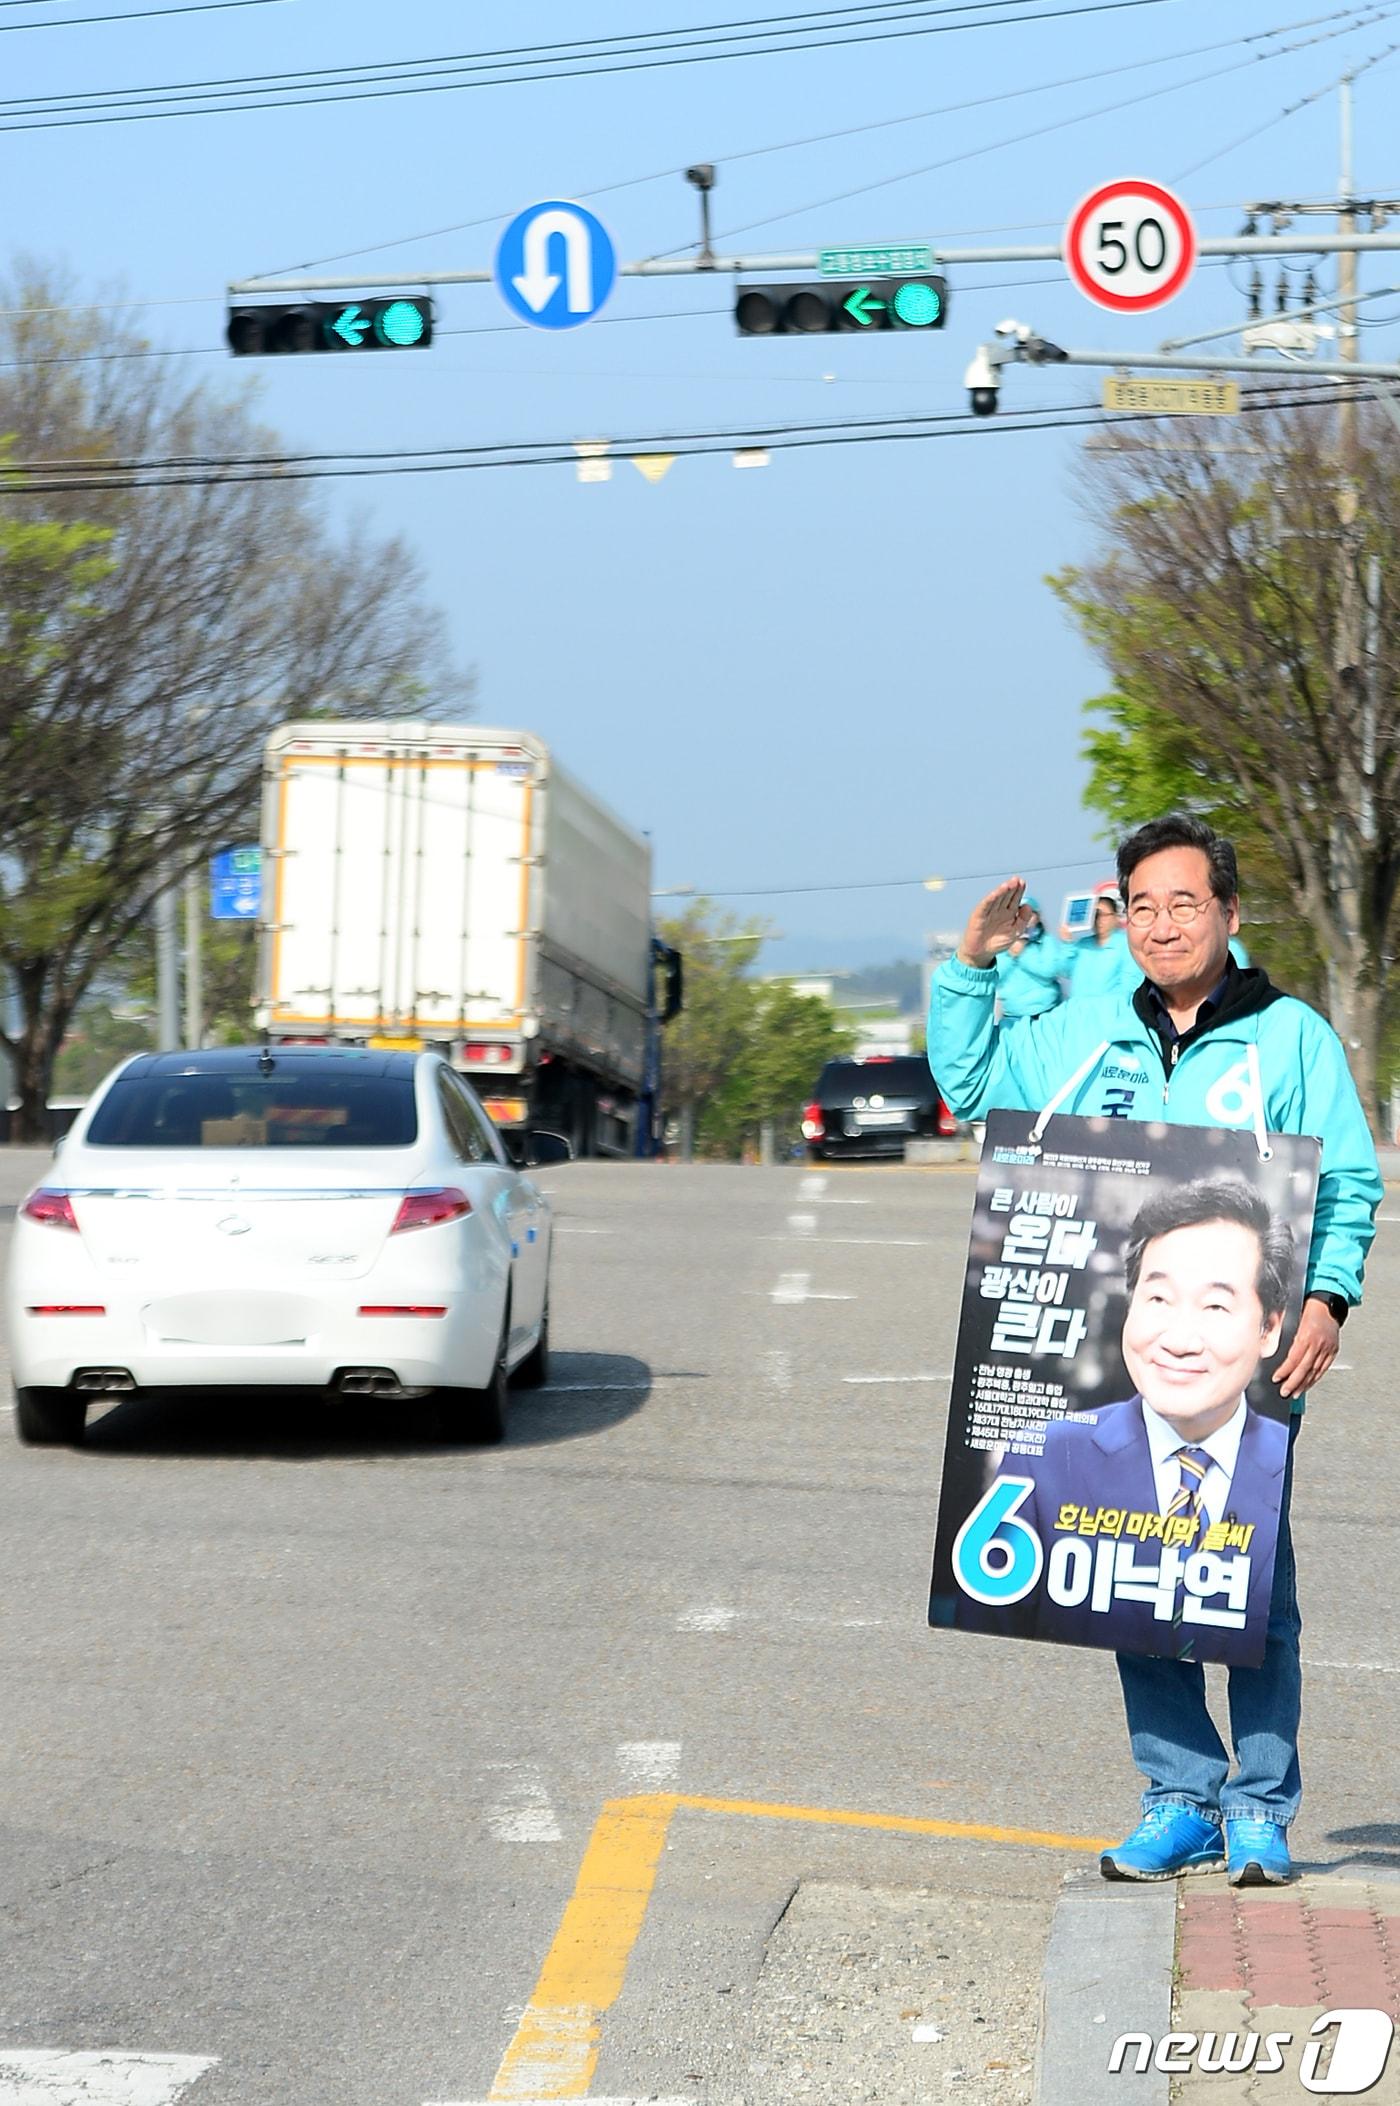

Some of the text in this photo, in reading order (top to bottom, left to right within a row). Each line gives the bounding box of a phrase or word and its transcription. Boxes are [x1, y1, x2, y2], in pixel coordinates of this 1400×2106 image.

[1097, 217, 1166, 273] 50
[1206, 1061, 1256, 1124] 6
[990, 1188, 1078, 1217] 큰 사람이
[1001, 1214, 1098, 1269] 온다
[980, 1265, 1069, 1305] 광산이
[990, 1301, 1088, 1358] 큰다
[951, 1474, 1252, 1630] 6 이낙연
[1054, 1503, 1255, 1553] 호남의 마지막 불씨
